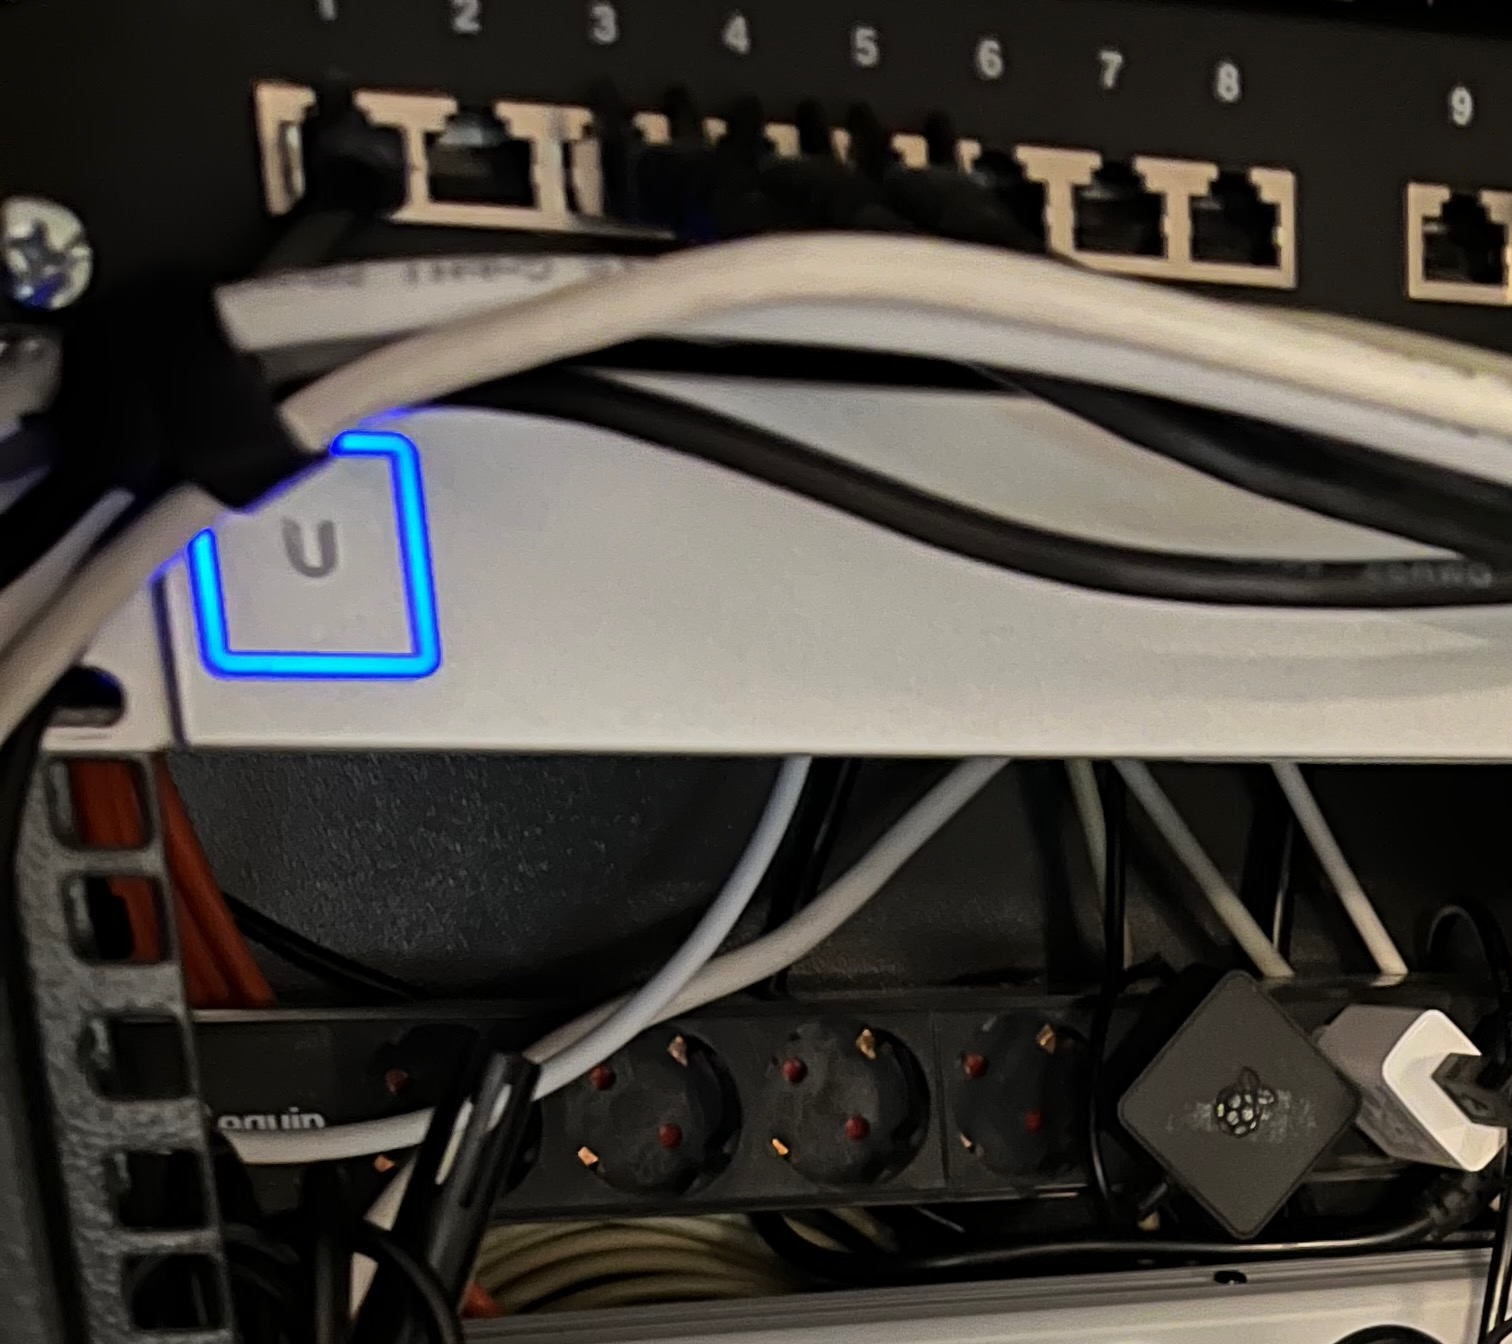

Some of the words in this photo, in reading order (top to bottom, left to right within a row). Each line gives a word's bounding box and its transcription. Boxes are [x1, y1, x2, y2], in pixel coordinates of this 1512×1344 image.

[452, 0, 481, 33] 2
[591, 3, 618, 43] 3
[724, 15, 750, 53] 4
[854, 27, 879, 66] 5
[977, 39, 1003, 78] 6
[1099, 50, 1123, 88] 7
[1216, 62, 1241, 102] 8
[1450, 87, 1474, 126] 9
[283, 519, 338, 579] U
